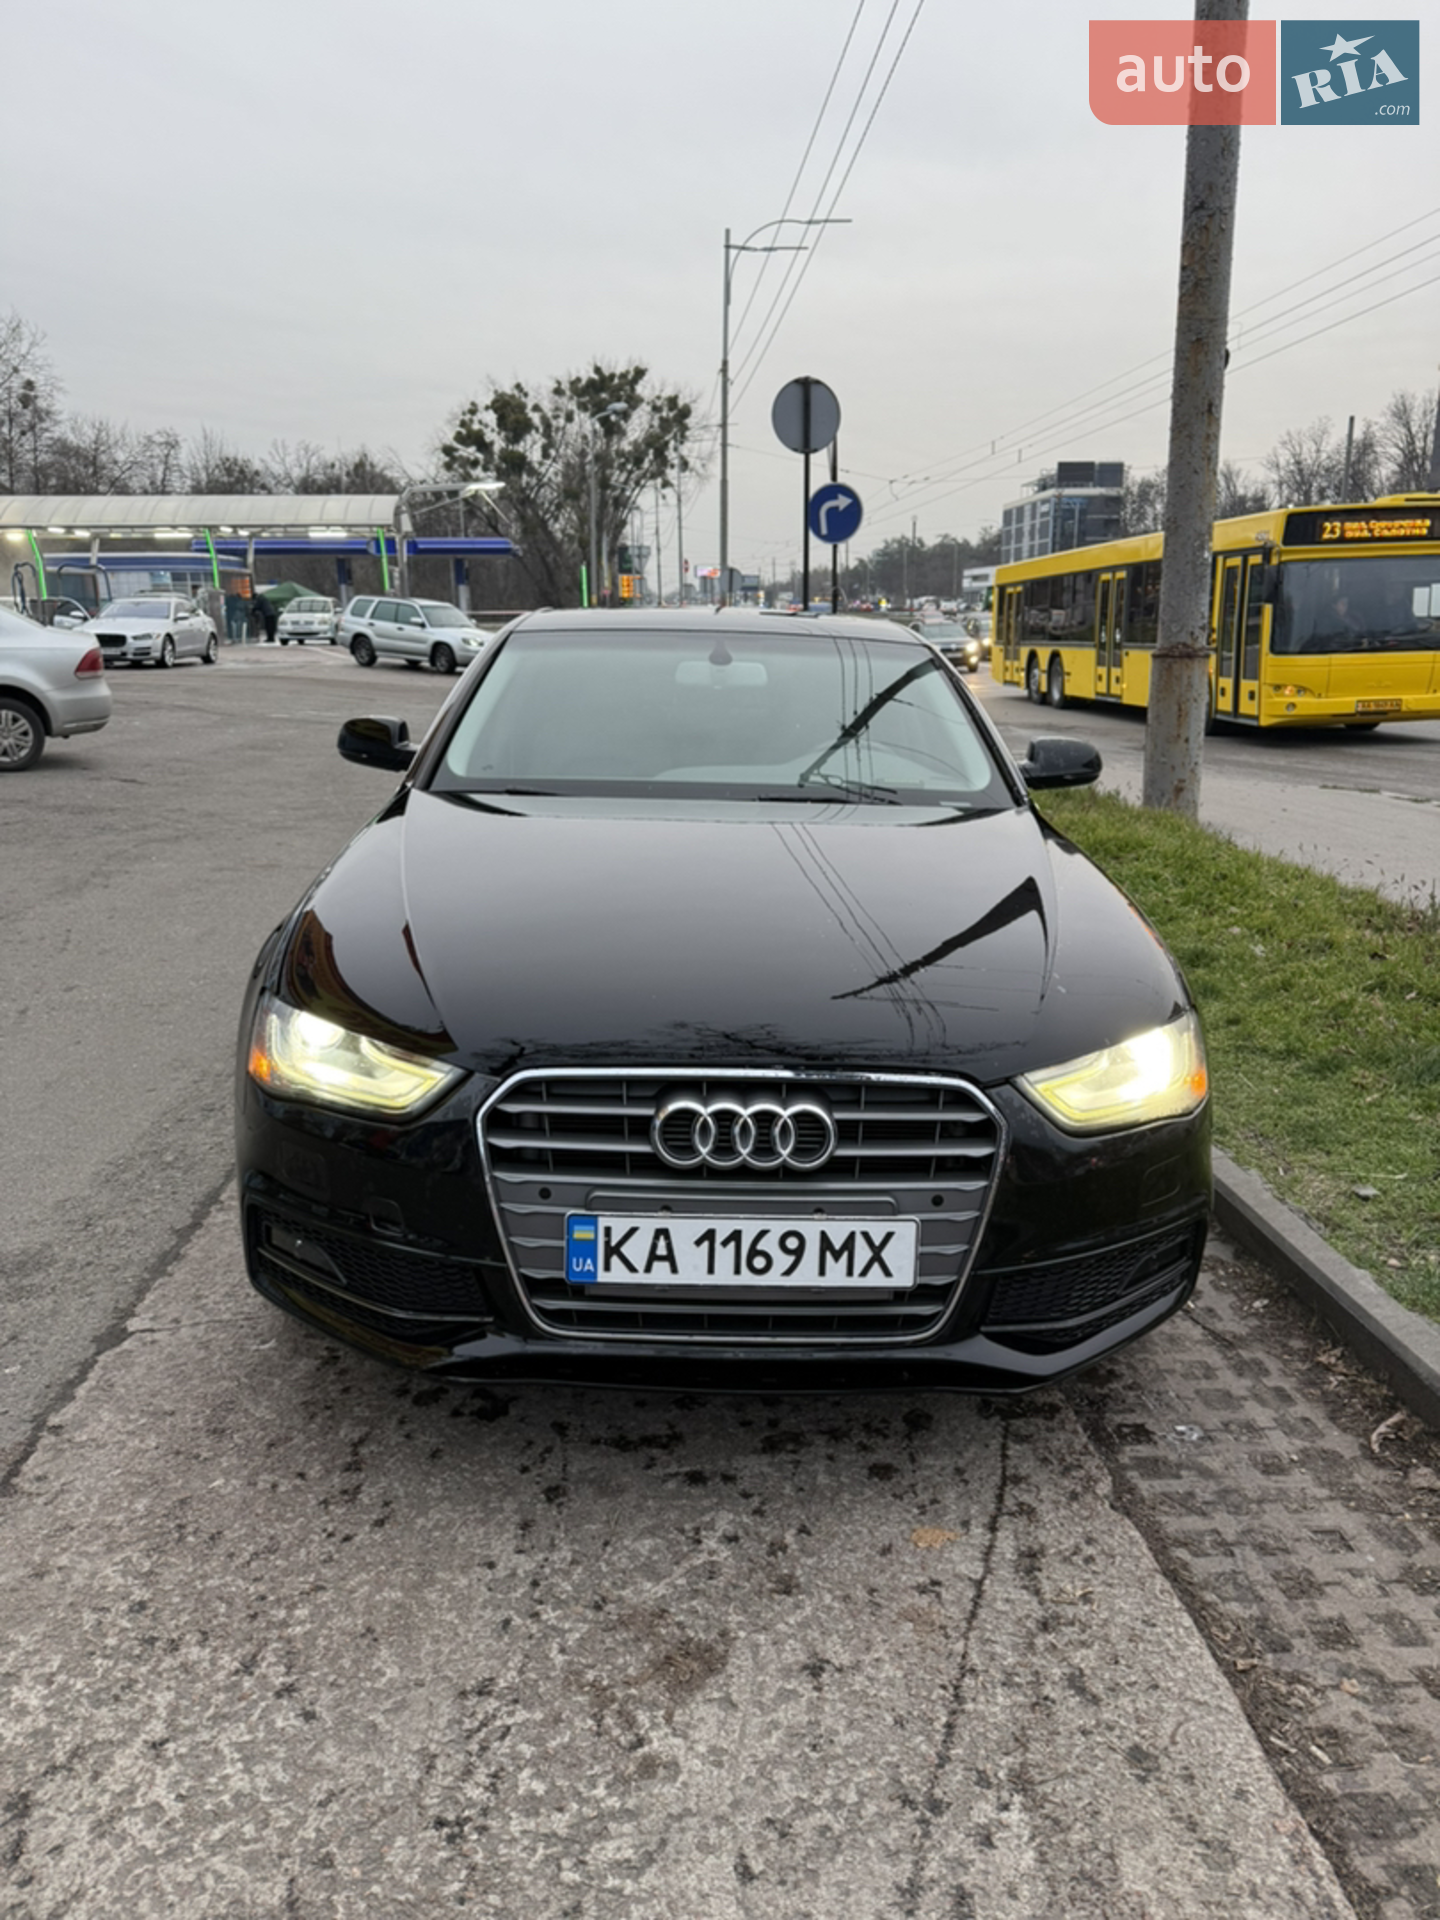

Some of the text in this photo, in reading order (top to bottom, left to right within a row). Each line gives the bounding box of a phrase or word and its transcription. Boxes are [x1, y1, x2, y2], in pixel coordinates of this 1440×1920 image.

[1322, 521, 1341, 540] 23
[603, 1226, 896, 1278] KA 1169 MX
[572, 1258, 595, 1273] UA
